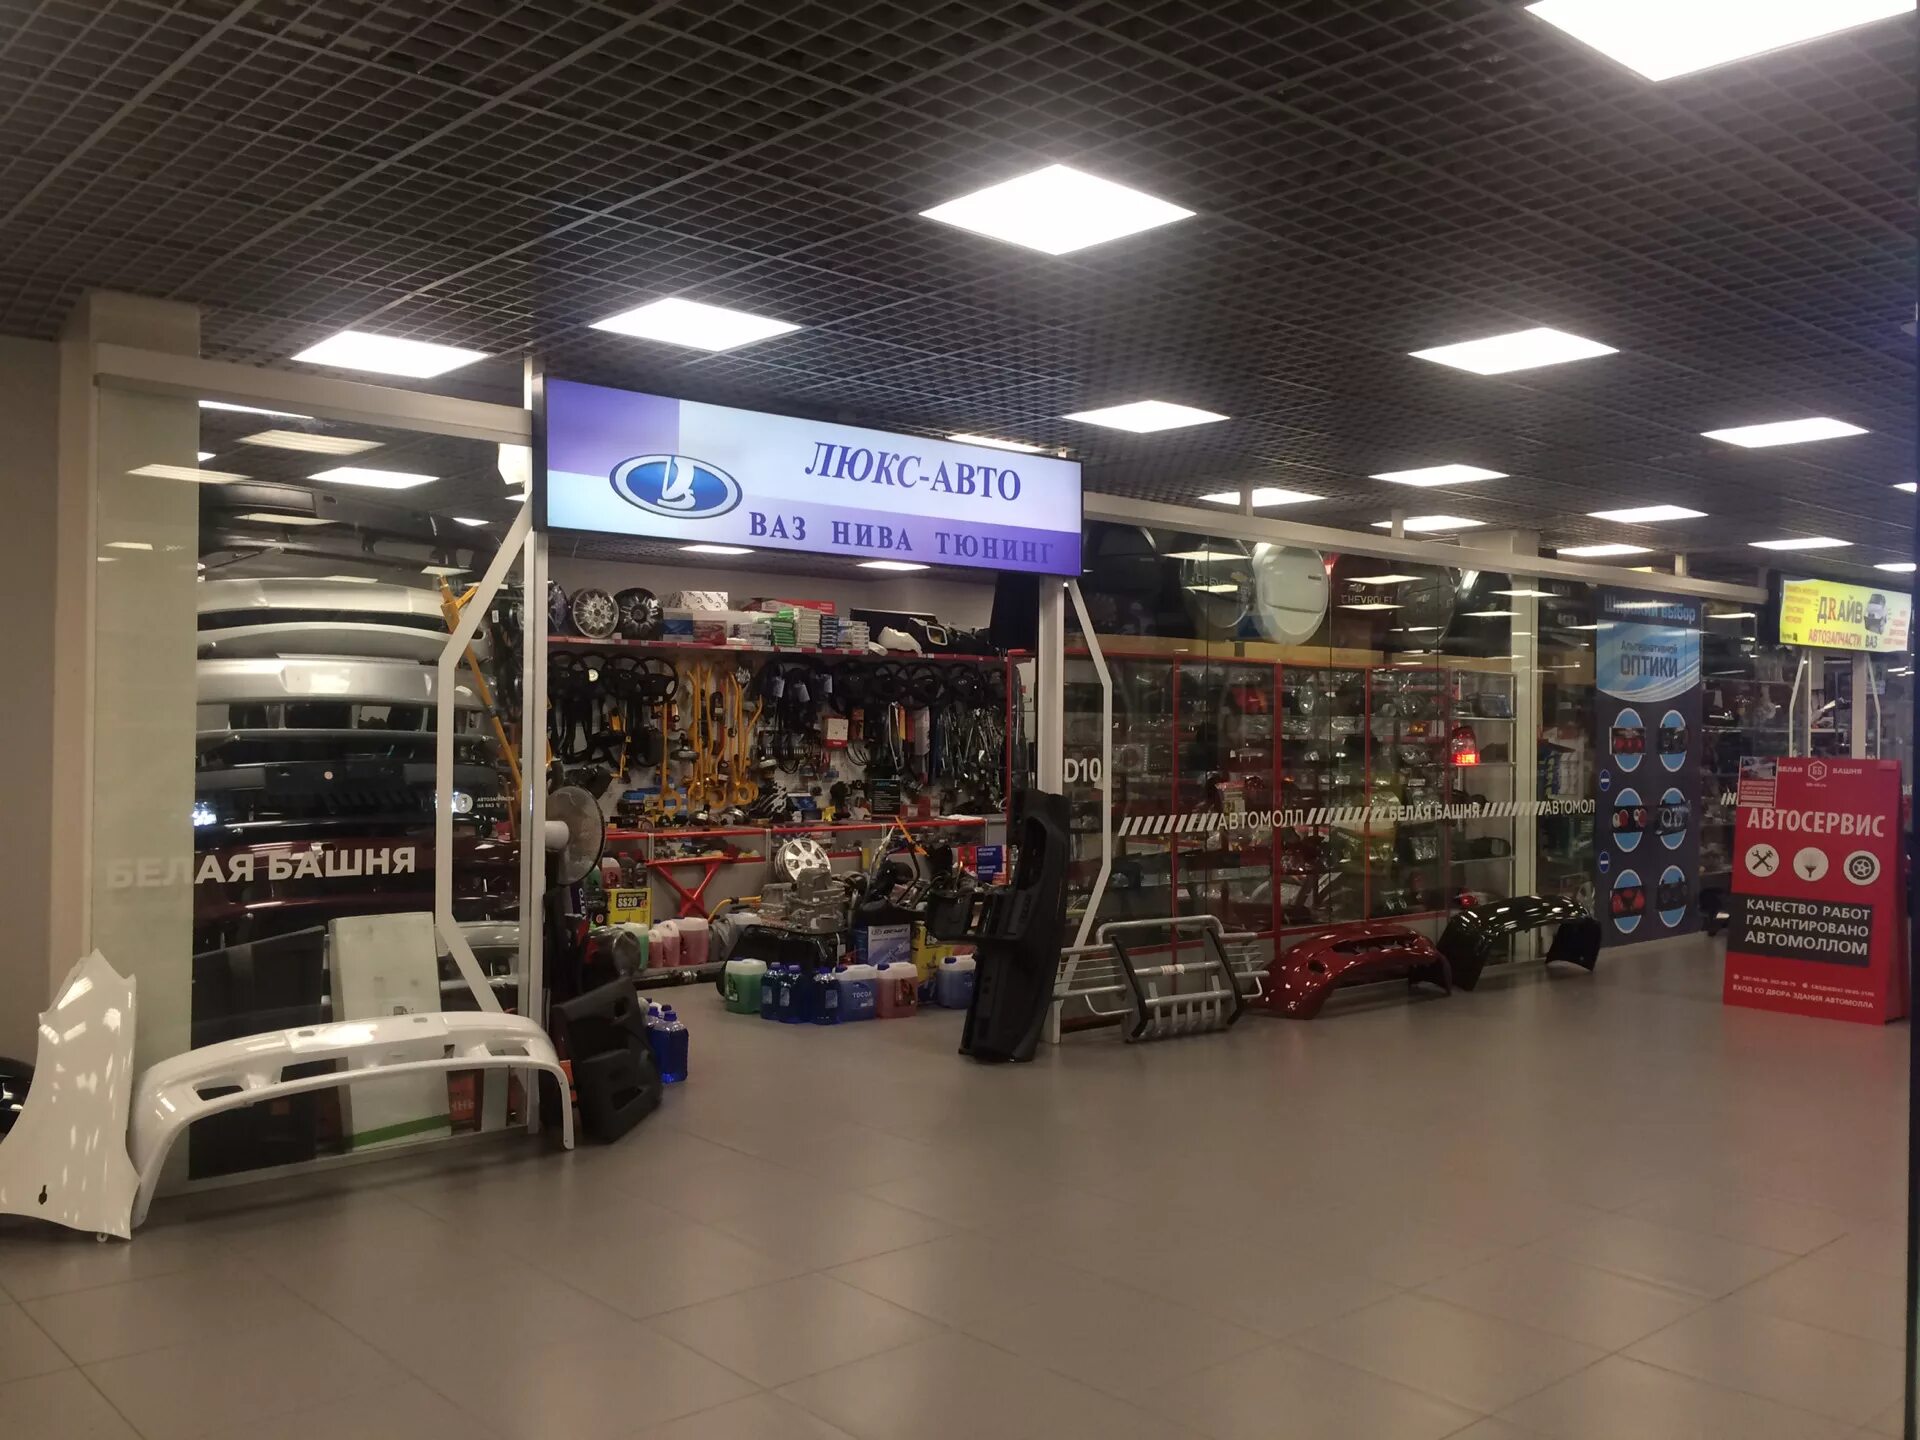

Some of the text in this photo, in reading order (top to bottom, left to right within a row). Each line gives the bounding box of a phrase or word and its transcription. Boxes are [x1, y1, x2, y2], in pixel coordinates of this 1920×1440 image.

[805, 442, 1021, 502] ЛЮКС-АВТО
[749, 512, 1054, 564] ВАЗ НИВА ТЮНИНГ
[1808, 628, 1862, 647] АВТОЗАПЧАСТИ
[1865, 635, 1878, 648] ВАЗ
[1621, 654, 1678, 678] ОПТИКИ
[1064, 758, 1101, 783] D10
[1832, 767, 1862, 775] БАШНЯ
[1217, 809, 1304, 830] АВТОМОЛЛ
[1389, 804, 1431, 822] БЕЛАЯ
[1435, 802, 1480, 820] БАШНЯ
[1747, 808, 1886, 838] АВТОСЕРВИС
[107, 847, 416, 888] БЕЛАЯ БАШНЯ
[617, 897, 638, 907] SS20
[1747, 899, 1871, 921] КАЧЕСТВО РАБОТ
[1746, 915, 1869, 937] ГАРАНТИРОВАНО
[1745, 930, 1868, 955] АВТОМОЛЛОМ
[1733, 984, 1753, 993] ВХОД
[1766, 988, 1791, 998] ДВОРА
[1793, 993, 1823, 1002] ЗДАНИЯ
[1825, 996, 1874, 1009] АВТОМОЛЛА
